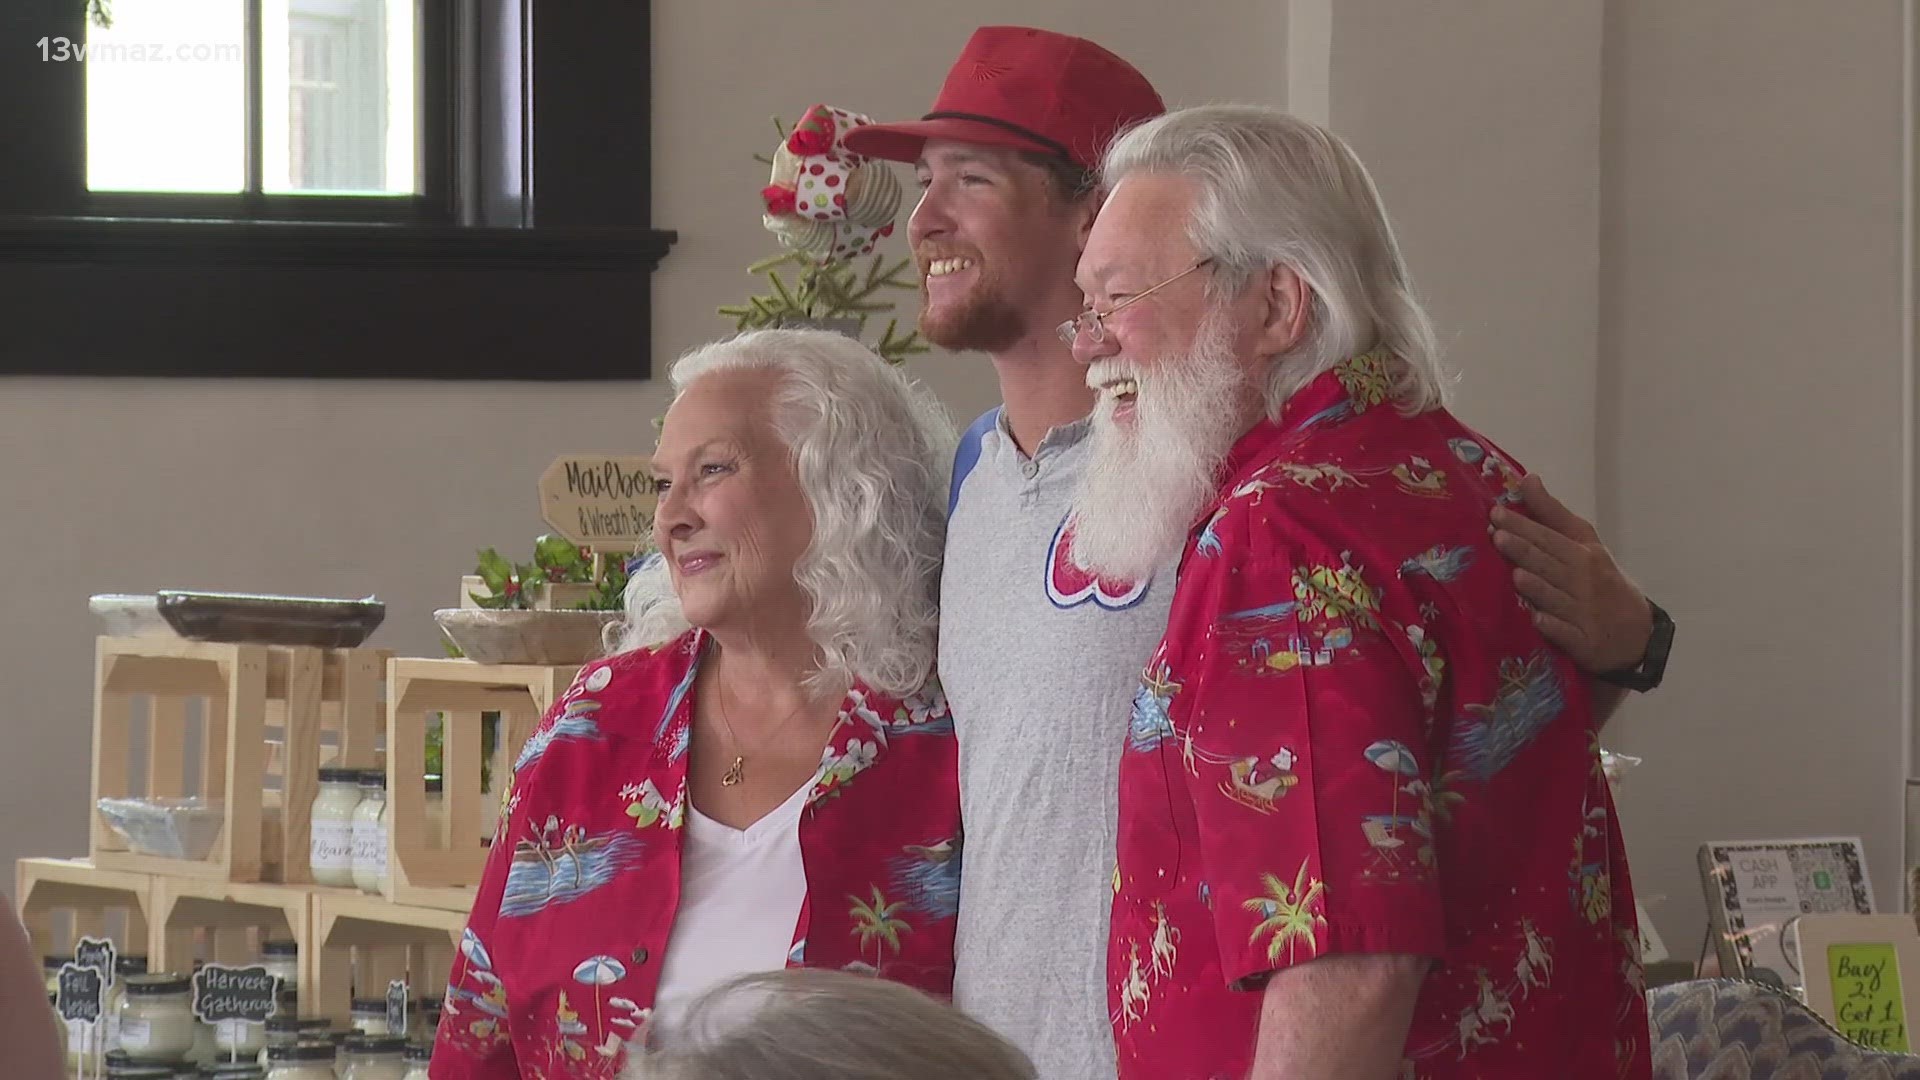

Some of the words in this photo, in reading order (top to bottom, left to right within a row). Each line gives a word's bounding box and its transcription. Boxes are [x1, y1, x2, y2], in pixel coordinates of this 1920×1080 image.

[586, 505, 630, 537] Wreath
[1739, 858, 1780, 873] CASH
[1751, 875, 1778, 890] APP
[206, 968, 269, 991] Harvest
[1839, 1000, 1873, 1024] Get
[1846, 1023, 1904, 1048] FREE!
